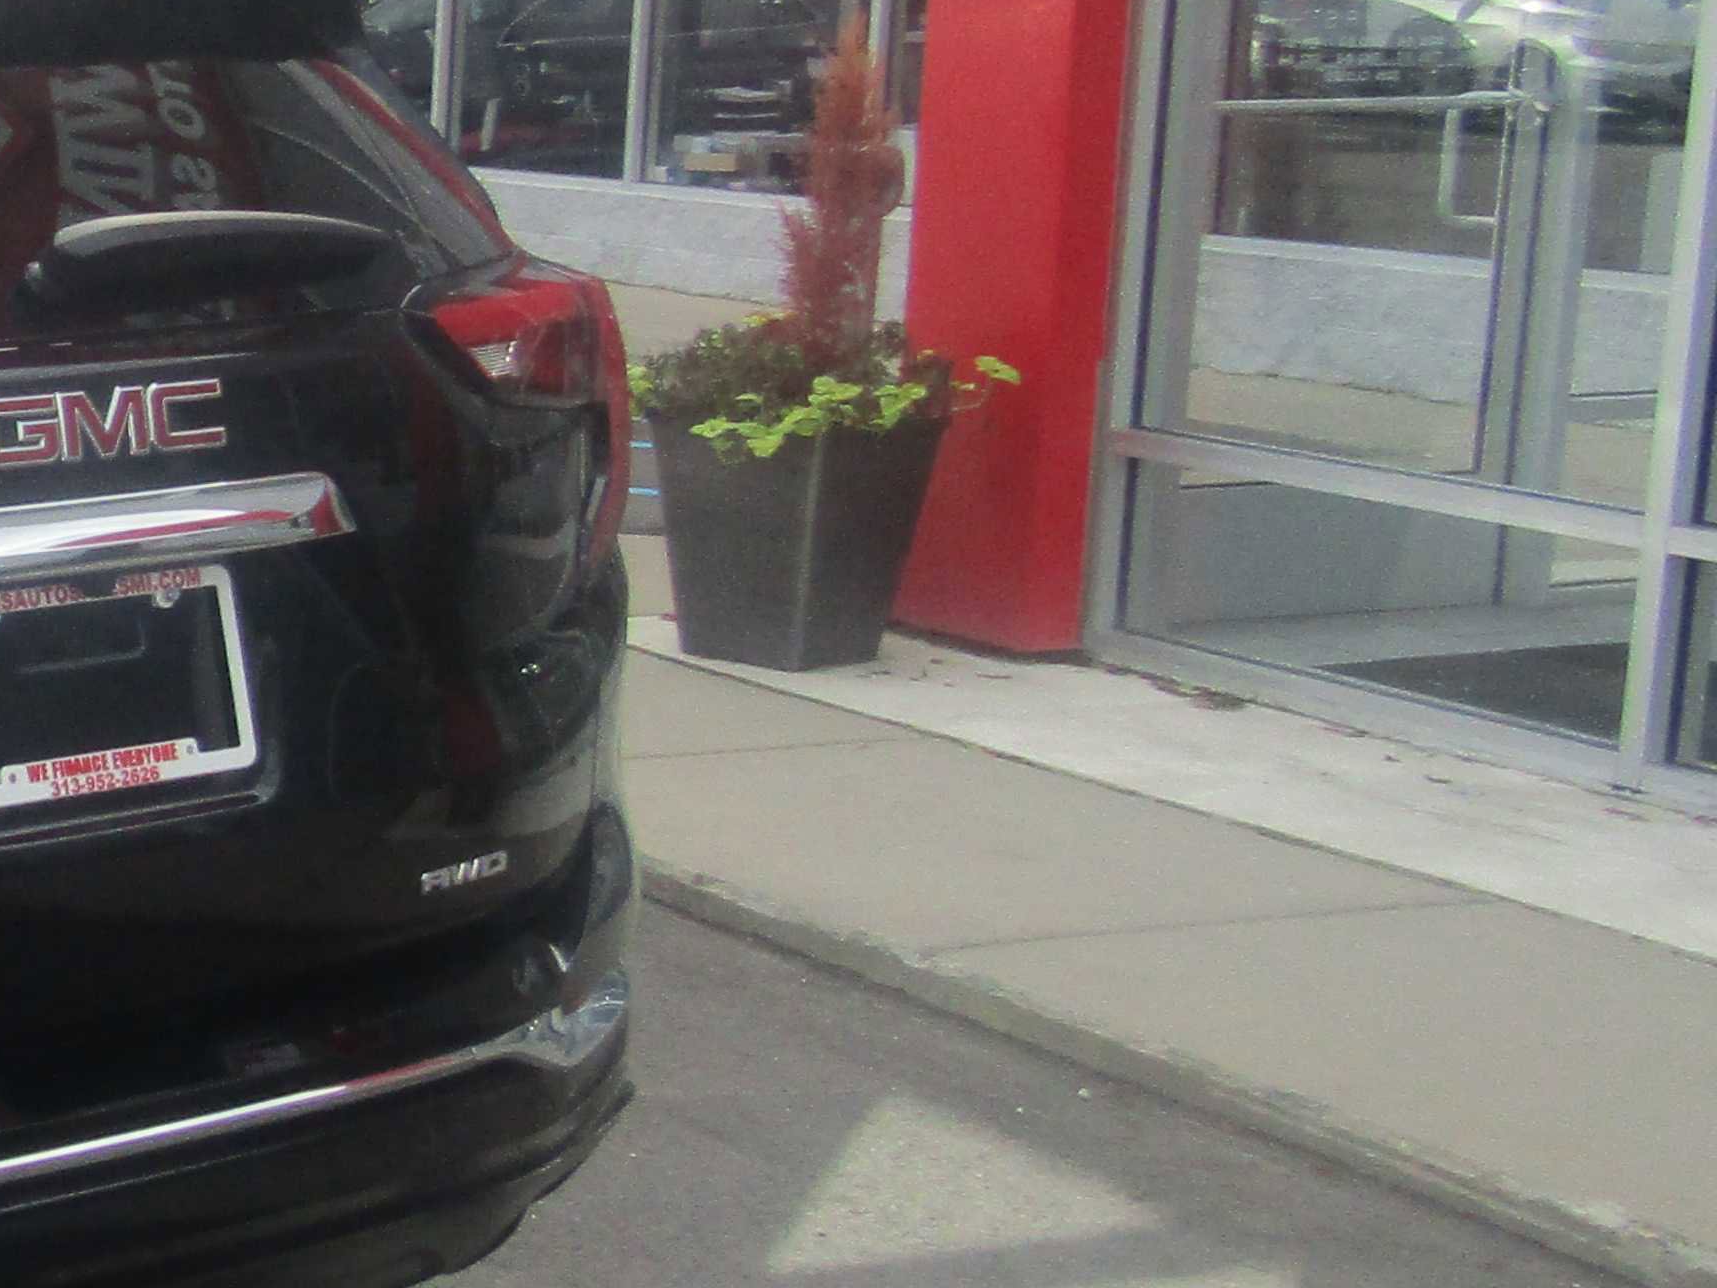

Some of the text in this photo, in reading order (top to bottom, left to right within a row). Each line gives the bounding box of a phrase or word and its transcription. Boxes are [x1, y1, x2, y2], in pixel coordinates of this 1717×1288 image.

[26, 743, 178, 783] WE FINANCE EVERYONE
[420, 850, 509, 896] AWD
